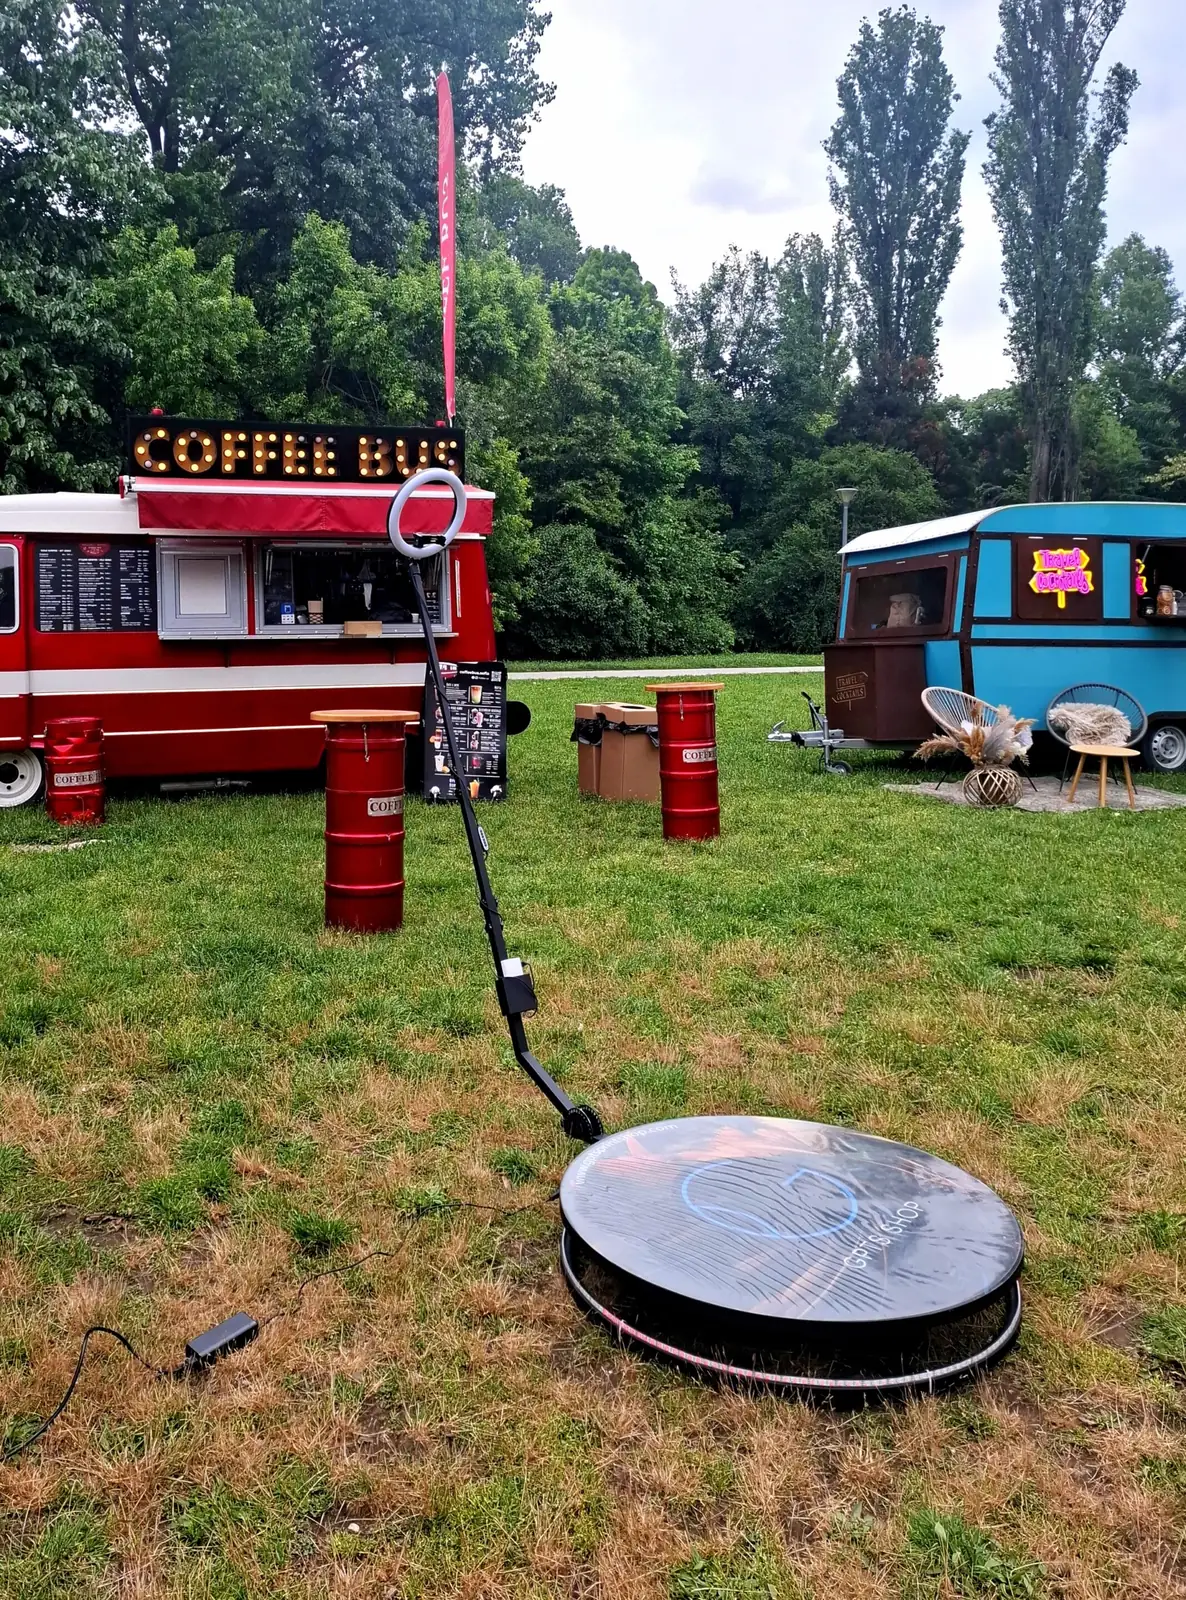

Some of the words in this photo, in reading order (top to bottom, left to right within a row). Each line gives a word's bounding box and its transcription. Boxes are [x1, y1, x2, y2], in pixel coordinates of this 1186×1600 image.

[133, 426, 340, 476] COFFEE
[358, 435, 462, 479] BUS
[838, 675, 858, 687] TRAVEL
[836, 687, 864, 701] COCKTAILS
[55, 773, 94, 784] COFFEE
[881, 1201, 924, 1234] SHOP
